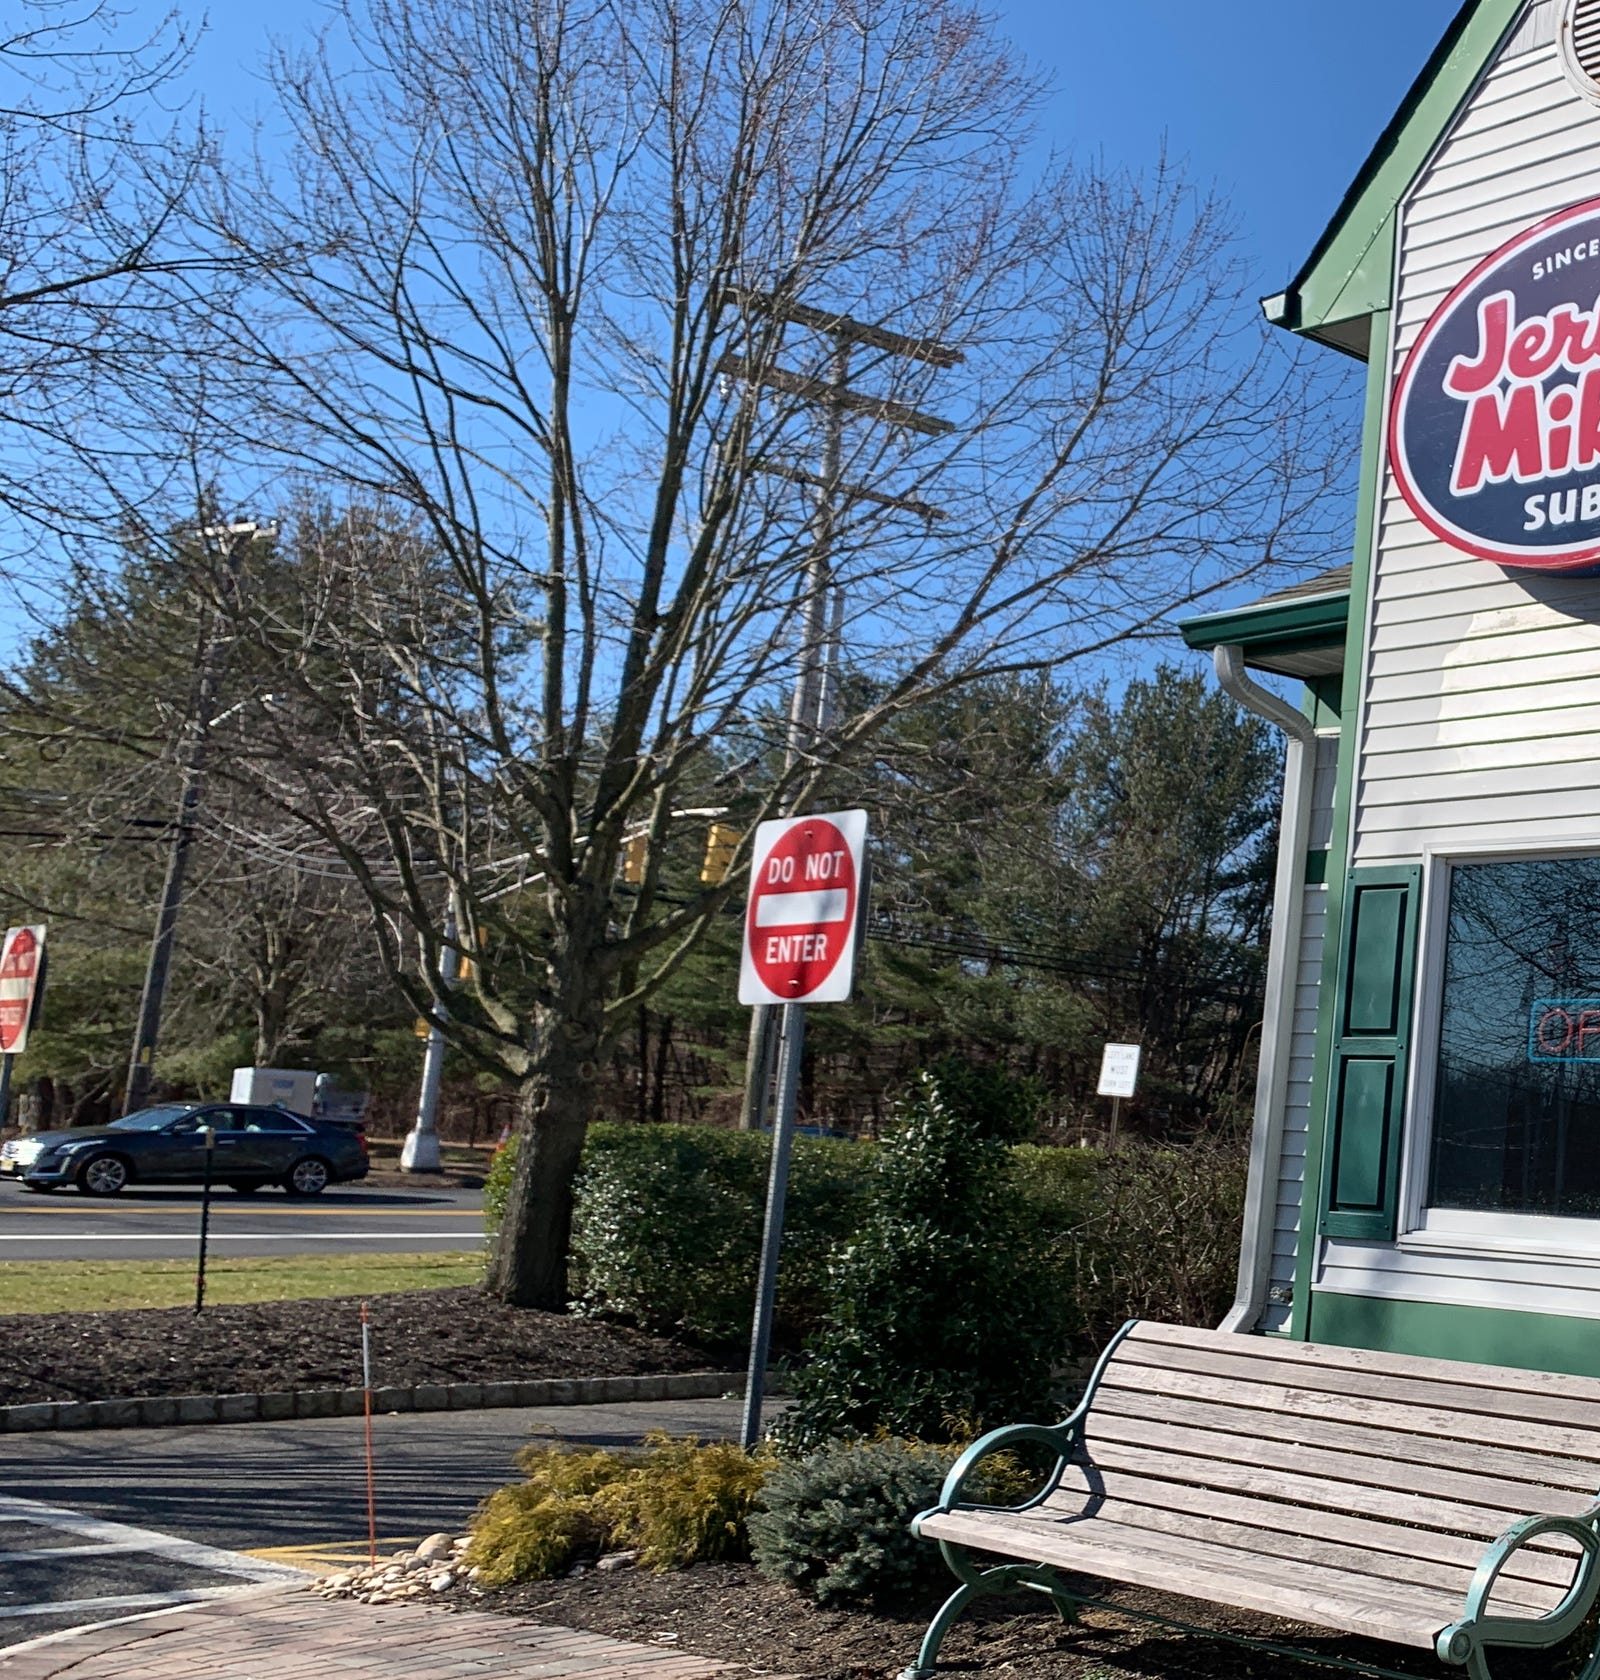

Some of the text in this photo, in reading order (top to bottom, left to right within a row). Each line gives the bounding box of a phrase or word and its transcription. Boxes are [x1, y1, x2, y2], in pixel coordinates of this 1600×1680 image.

[1531, 238, 1600, 280] SINCE
[768, 851, 845, 885] DO NOT
[765, 933, 828, 965] ENTER
